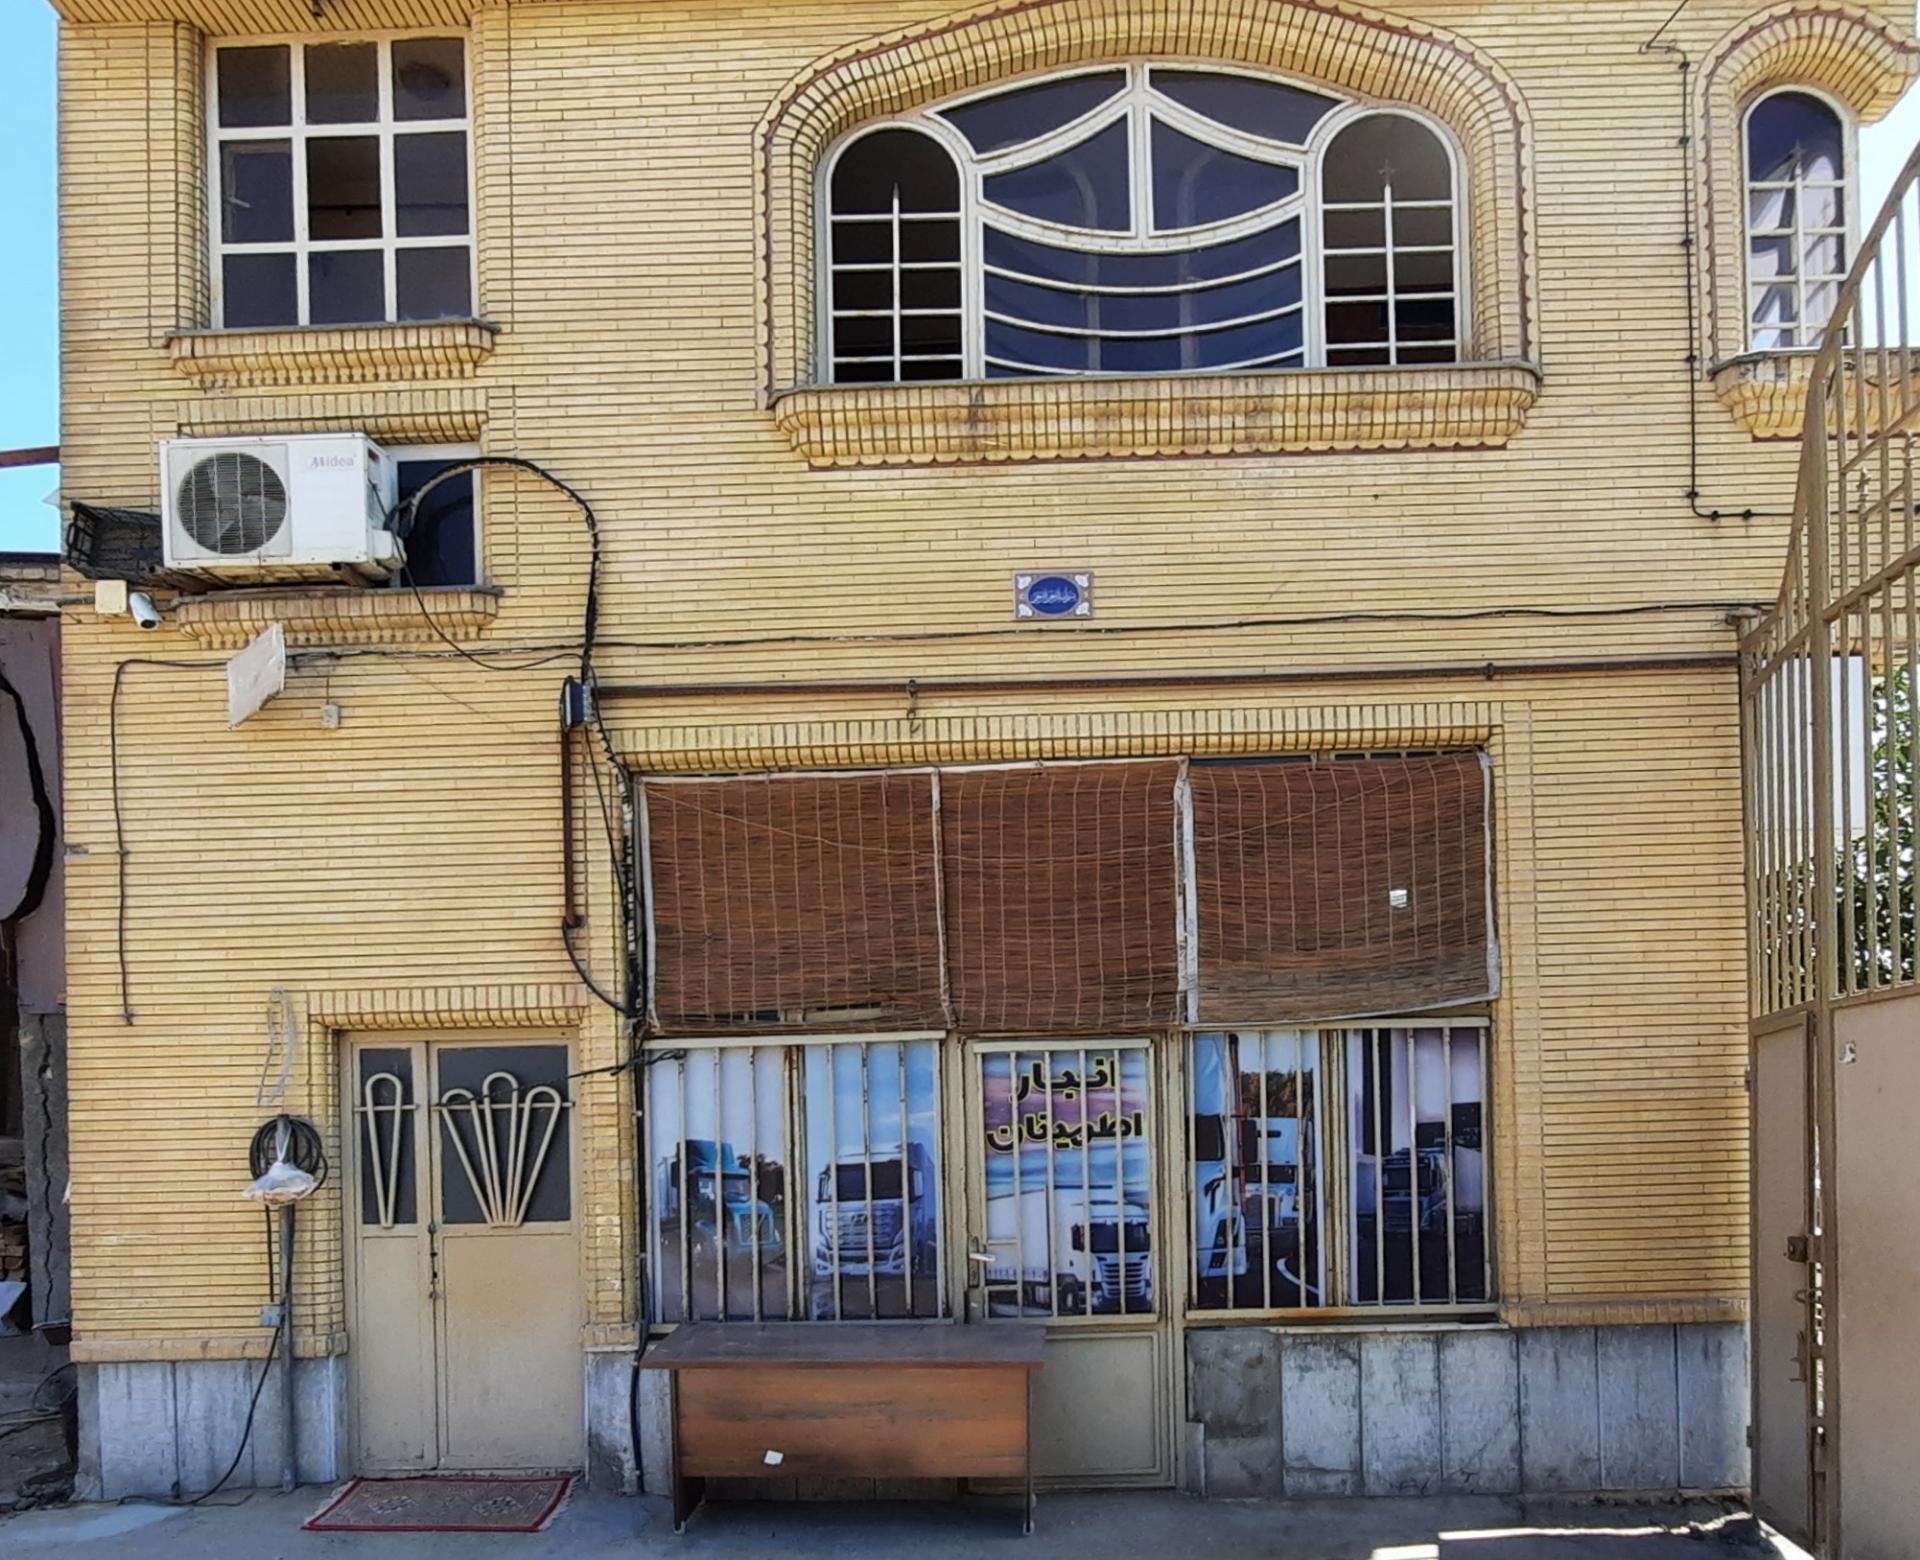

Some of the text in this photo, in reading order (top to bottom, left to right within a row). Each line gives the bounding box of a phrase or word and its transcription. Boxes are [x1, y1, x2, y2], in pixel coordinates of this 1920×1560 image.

[311, 455, 354, 468] Midea
[1010, 1058, 1116, 1102] انبار
[986, 1111, 1143, 1152] اطمینان
